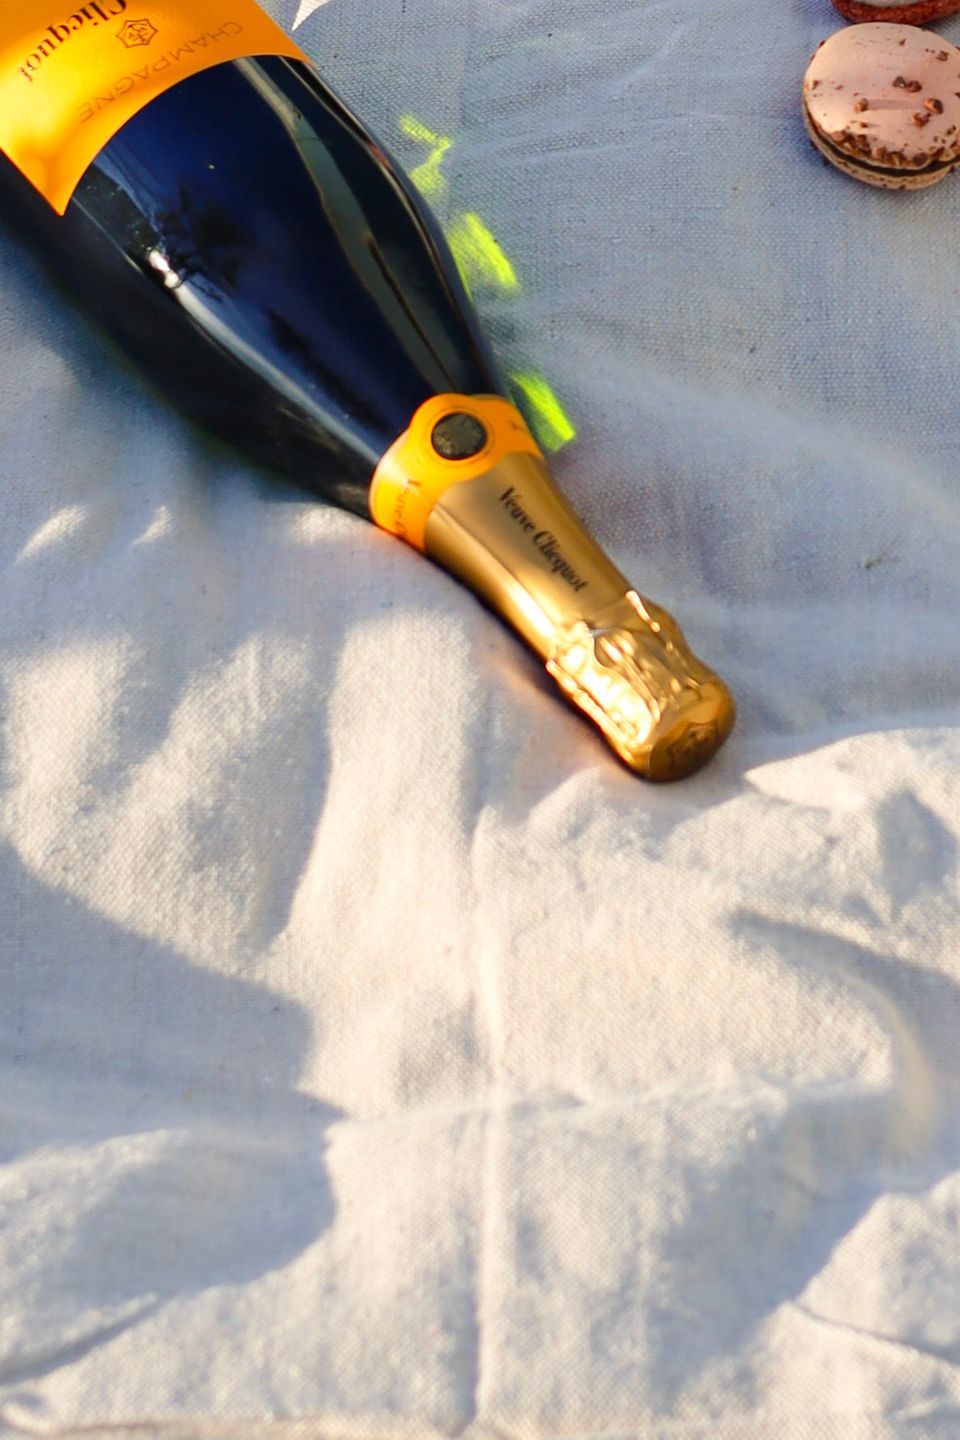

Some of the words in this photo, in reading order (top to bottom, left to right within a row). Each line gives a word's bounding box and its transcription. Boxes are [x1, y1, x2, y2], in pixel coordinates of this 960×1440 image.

[77, 21, 244, 125] CHAMPAGNE
[500, 486, 536, 533] Veuve
[532, 530, 588, 593] Clicquot
